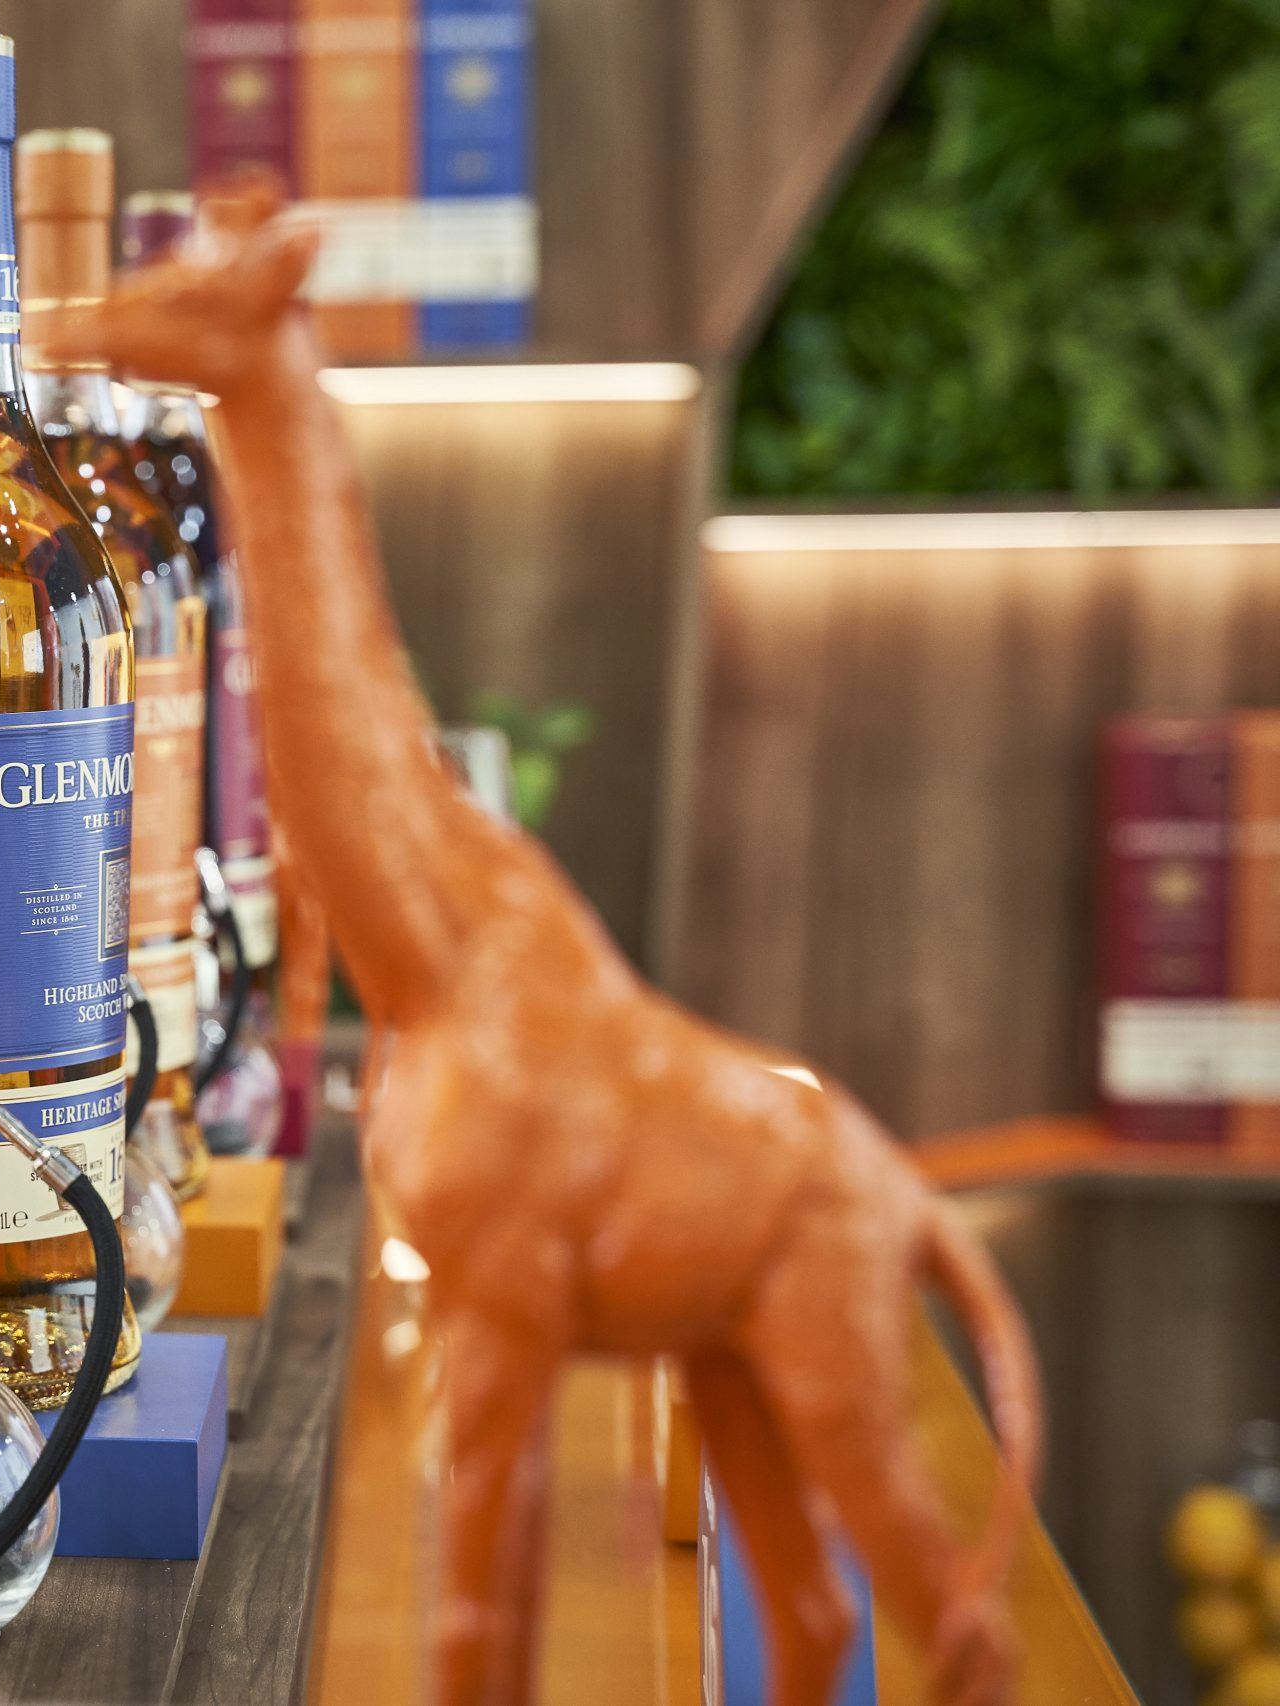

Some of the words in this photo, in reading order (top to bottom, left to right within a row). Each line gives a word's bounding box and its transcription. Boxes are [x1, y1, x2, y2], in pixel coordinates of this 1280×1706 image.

[83, 812, 111, 829] THE
[26, 893, 71, 905] DISTILLED
[73, 891, 83, 900] IN
[33, 903, 78, 915] SCOTLAND
[31, 917, 58, 926] SINCE
[61, 915, 79, 924] 1843
[43, 977, 118, 1006] HIGHLAND
[78, 997, 122, 1023] SCOTCH
[41, 1096, 112, 1128] HERITAGE
